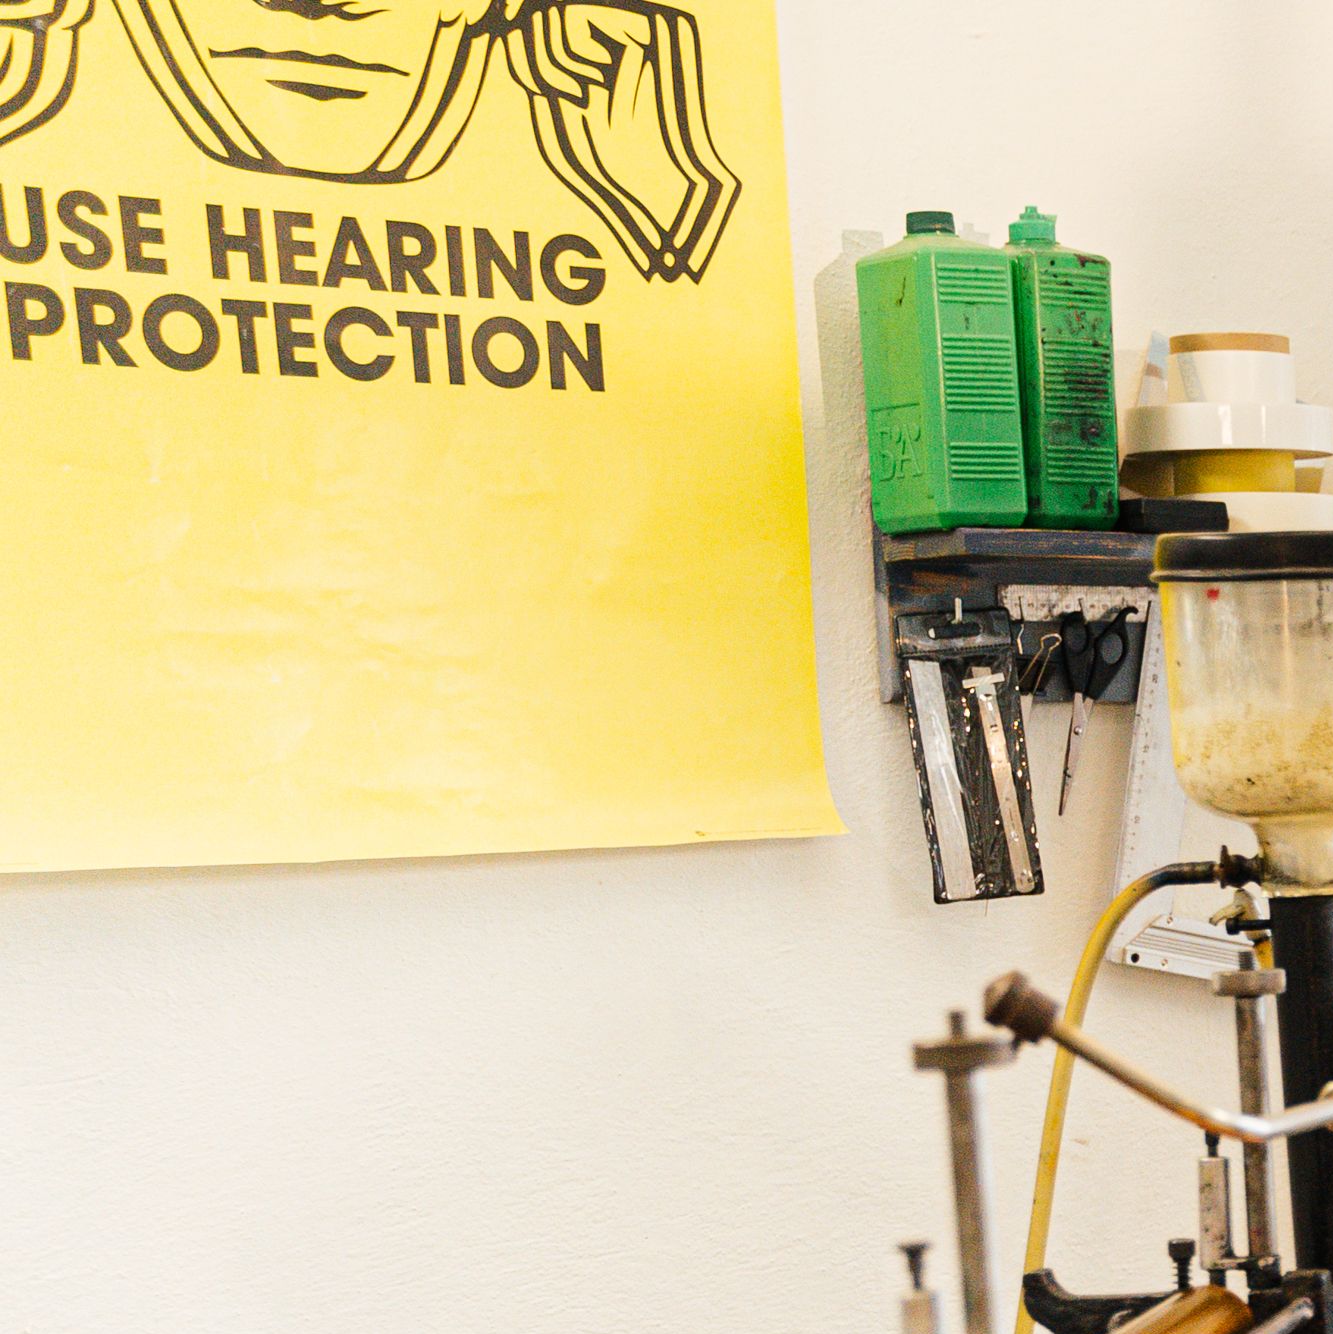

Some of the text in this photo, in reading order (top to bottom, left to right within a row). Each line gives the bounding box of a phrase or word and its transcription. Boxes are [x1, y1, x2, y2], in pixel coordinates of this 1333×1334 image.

[0, 182, 606, 306] USE HEARING
[4, 281, 606, 392] PROTECTION
